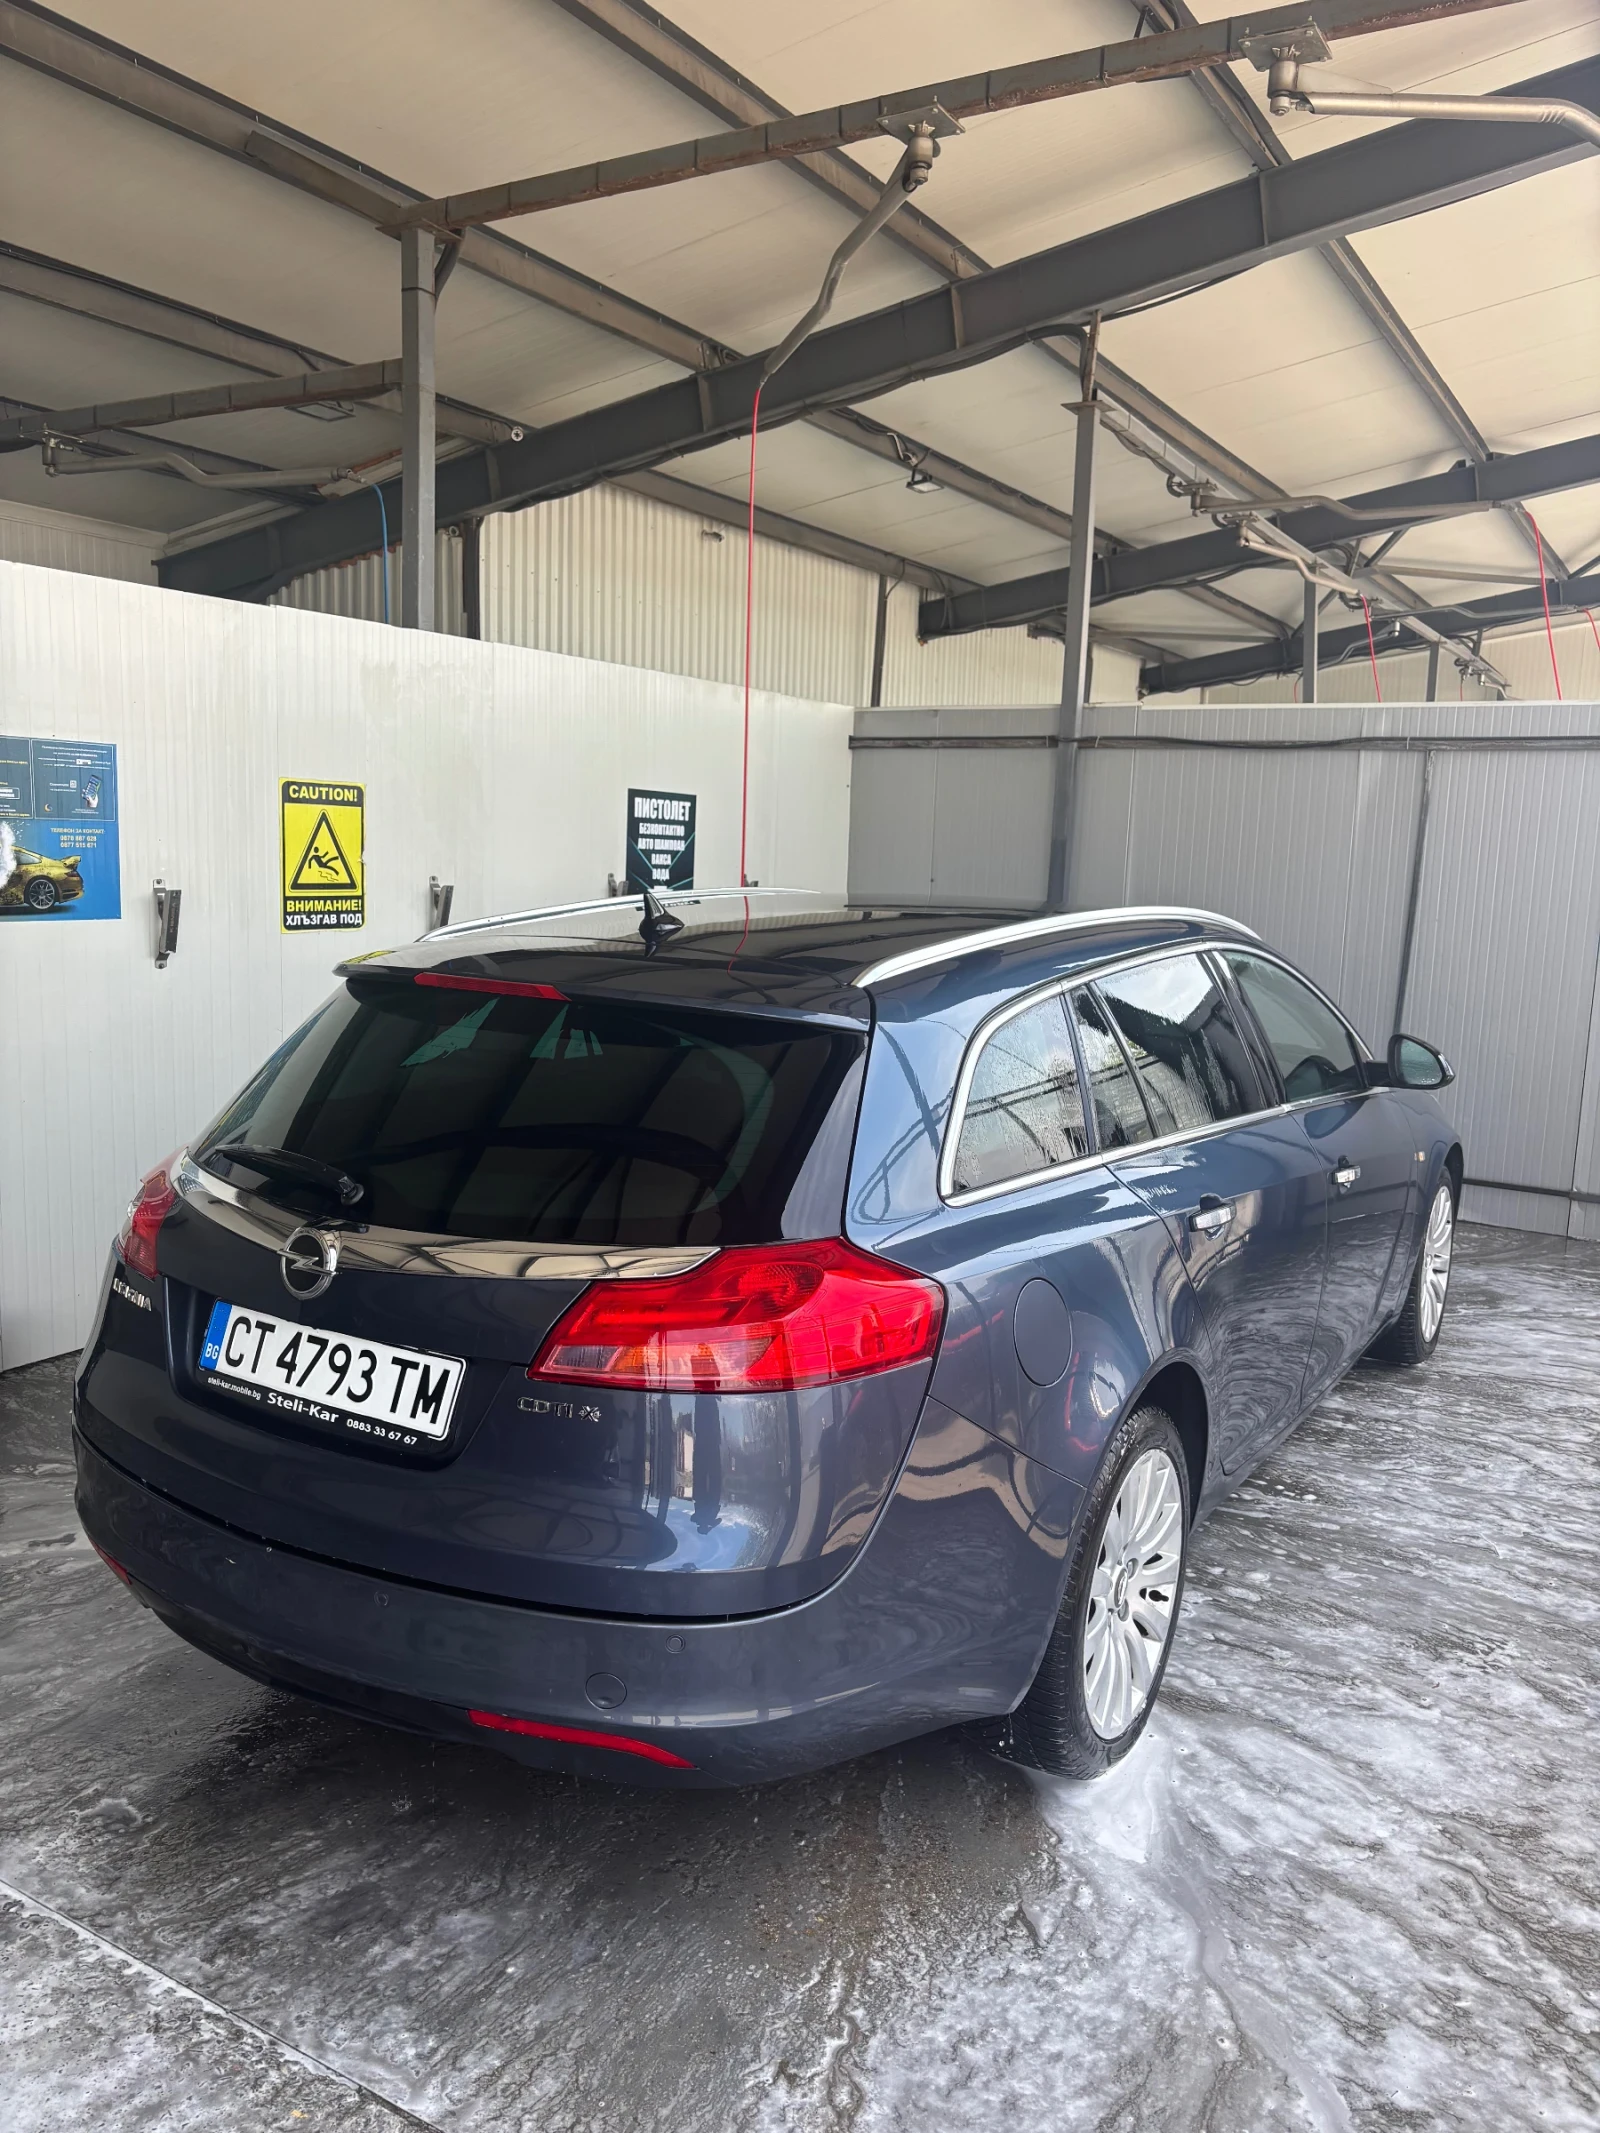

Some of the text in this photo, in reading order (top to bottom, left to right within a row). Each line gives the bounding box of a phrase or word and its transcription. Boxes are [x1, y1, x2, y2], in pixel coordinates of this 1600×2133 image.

[288, 785, 358, 802] CAUTION!
[634, 797, 691, 821] ПИСТОЛЕТ
[638, 838, 654, 850] АВТО
[652, 868, 670, 881] ВОДА
[286, 899, 362, 913] ВНИМАНИЕ!
[285, 913, 362, 927] ХЛЪЗГАВ ПОД
[204, 1342, 220, 1360] BG
[225, 1316, 451, 1425] CT 4793 TM
[207, 1376, 418, 1445] steli-kar.mobile.bg Steli-Kar 0883 33 67 67
[517, 1396, 573, 1418] CDTI
